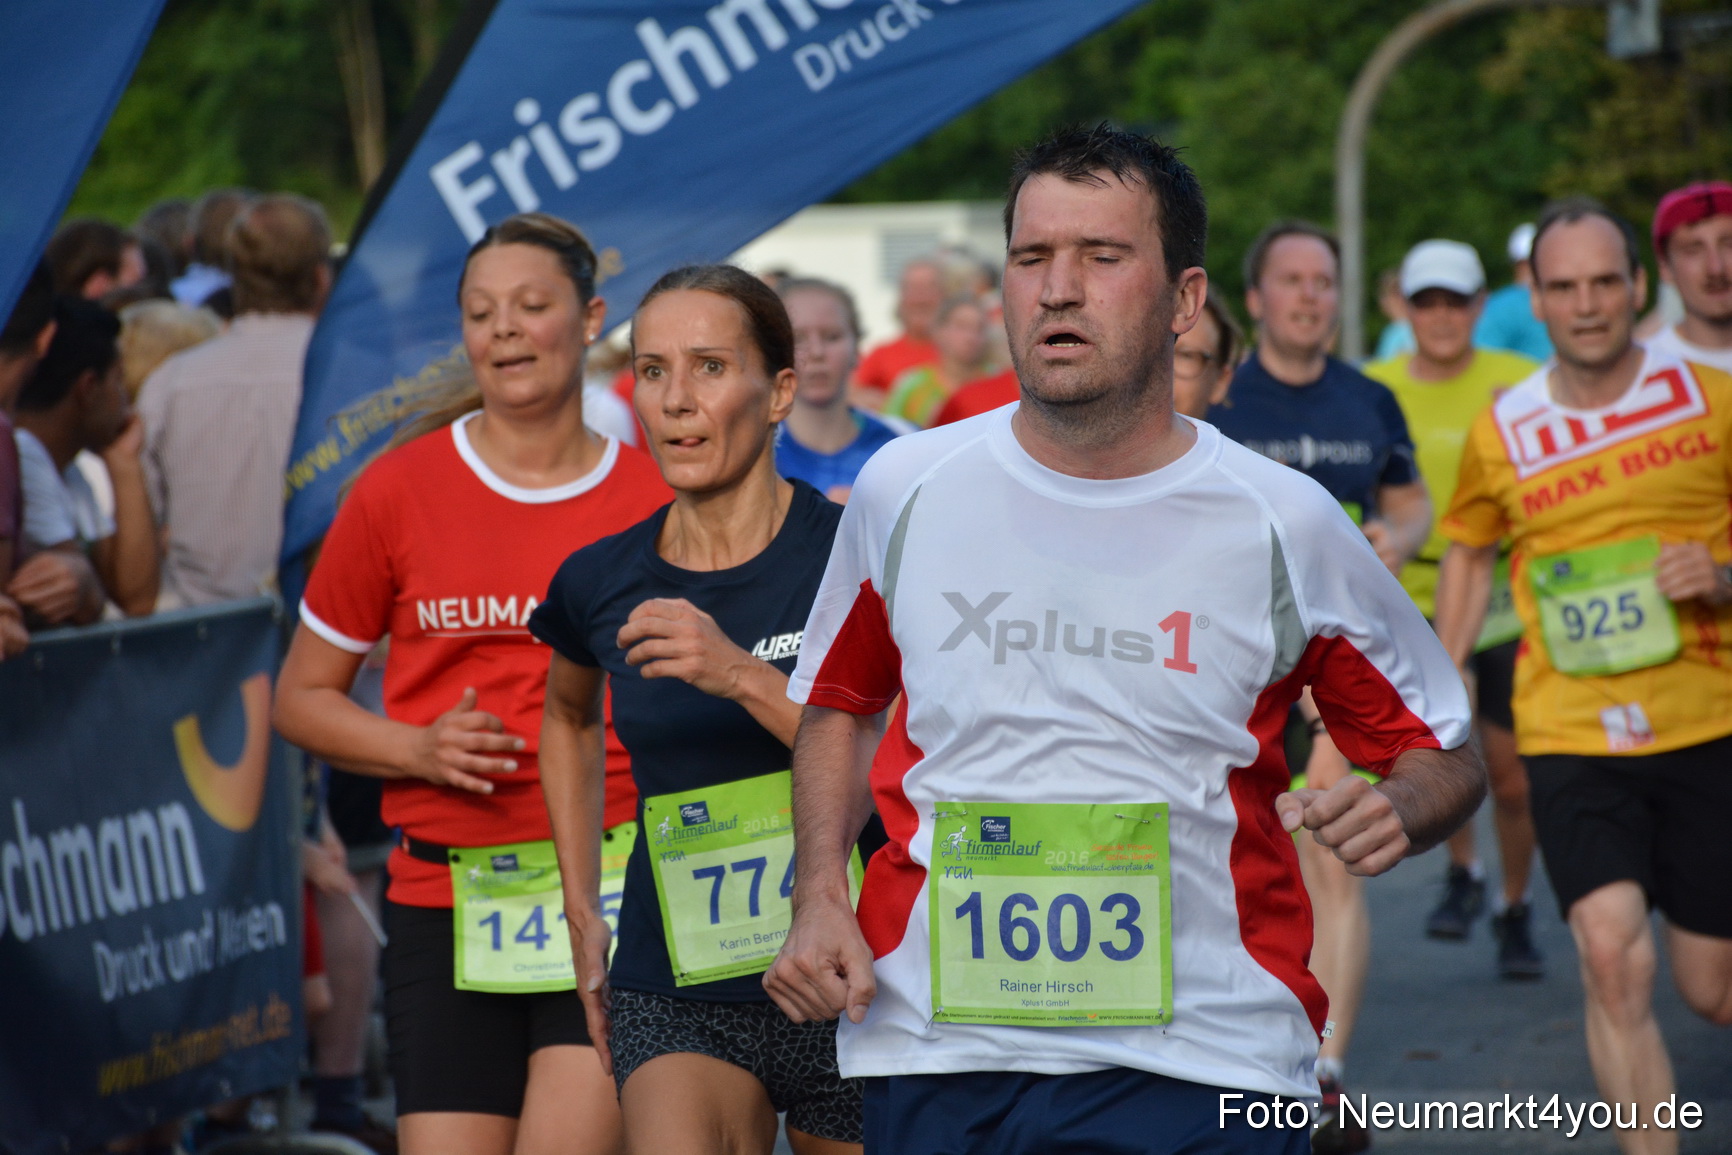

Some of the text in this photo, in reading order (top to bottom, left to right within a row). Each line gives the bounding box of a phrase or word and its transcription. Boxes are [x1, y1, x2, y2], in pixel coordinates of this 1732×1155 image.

[429, 0, 852, 247] Frischm
[1521, 430, 1720, 520] MAX BÖGL
[1562, 590, 1645, 642] 925
[672, 814, 738, 842] firmenlauf
[743, 815, 780, 835] 2016
[965, 839, 1090, 865] firmenlauf 2016
[0, 798, 206, 943] chmann
[478, 890, 624, 952] 145
[719, 937, 751, 951] Karin
[955, 891, 1145, 963] 1603
[93, 923, 166, 1004] Druck
[999, 978, 1094, 993] Rainer Hirsch
[1021, 999, 1070, 1007] Xplus1 GmbH
